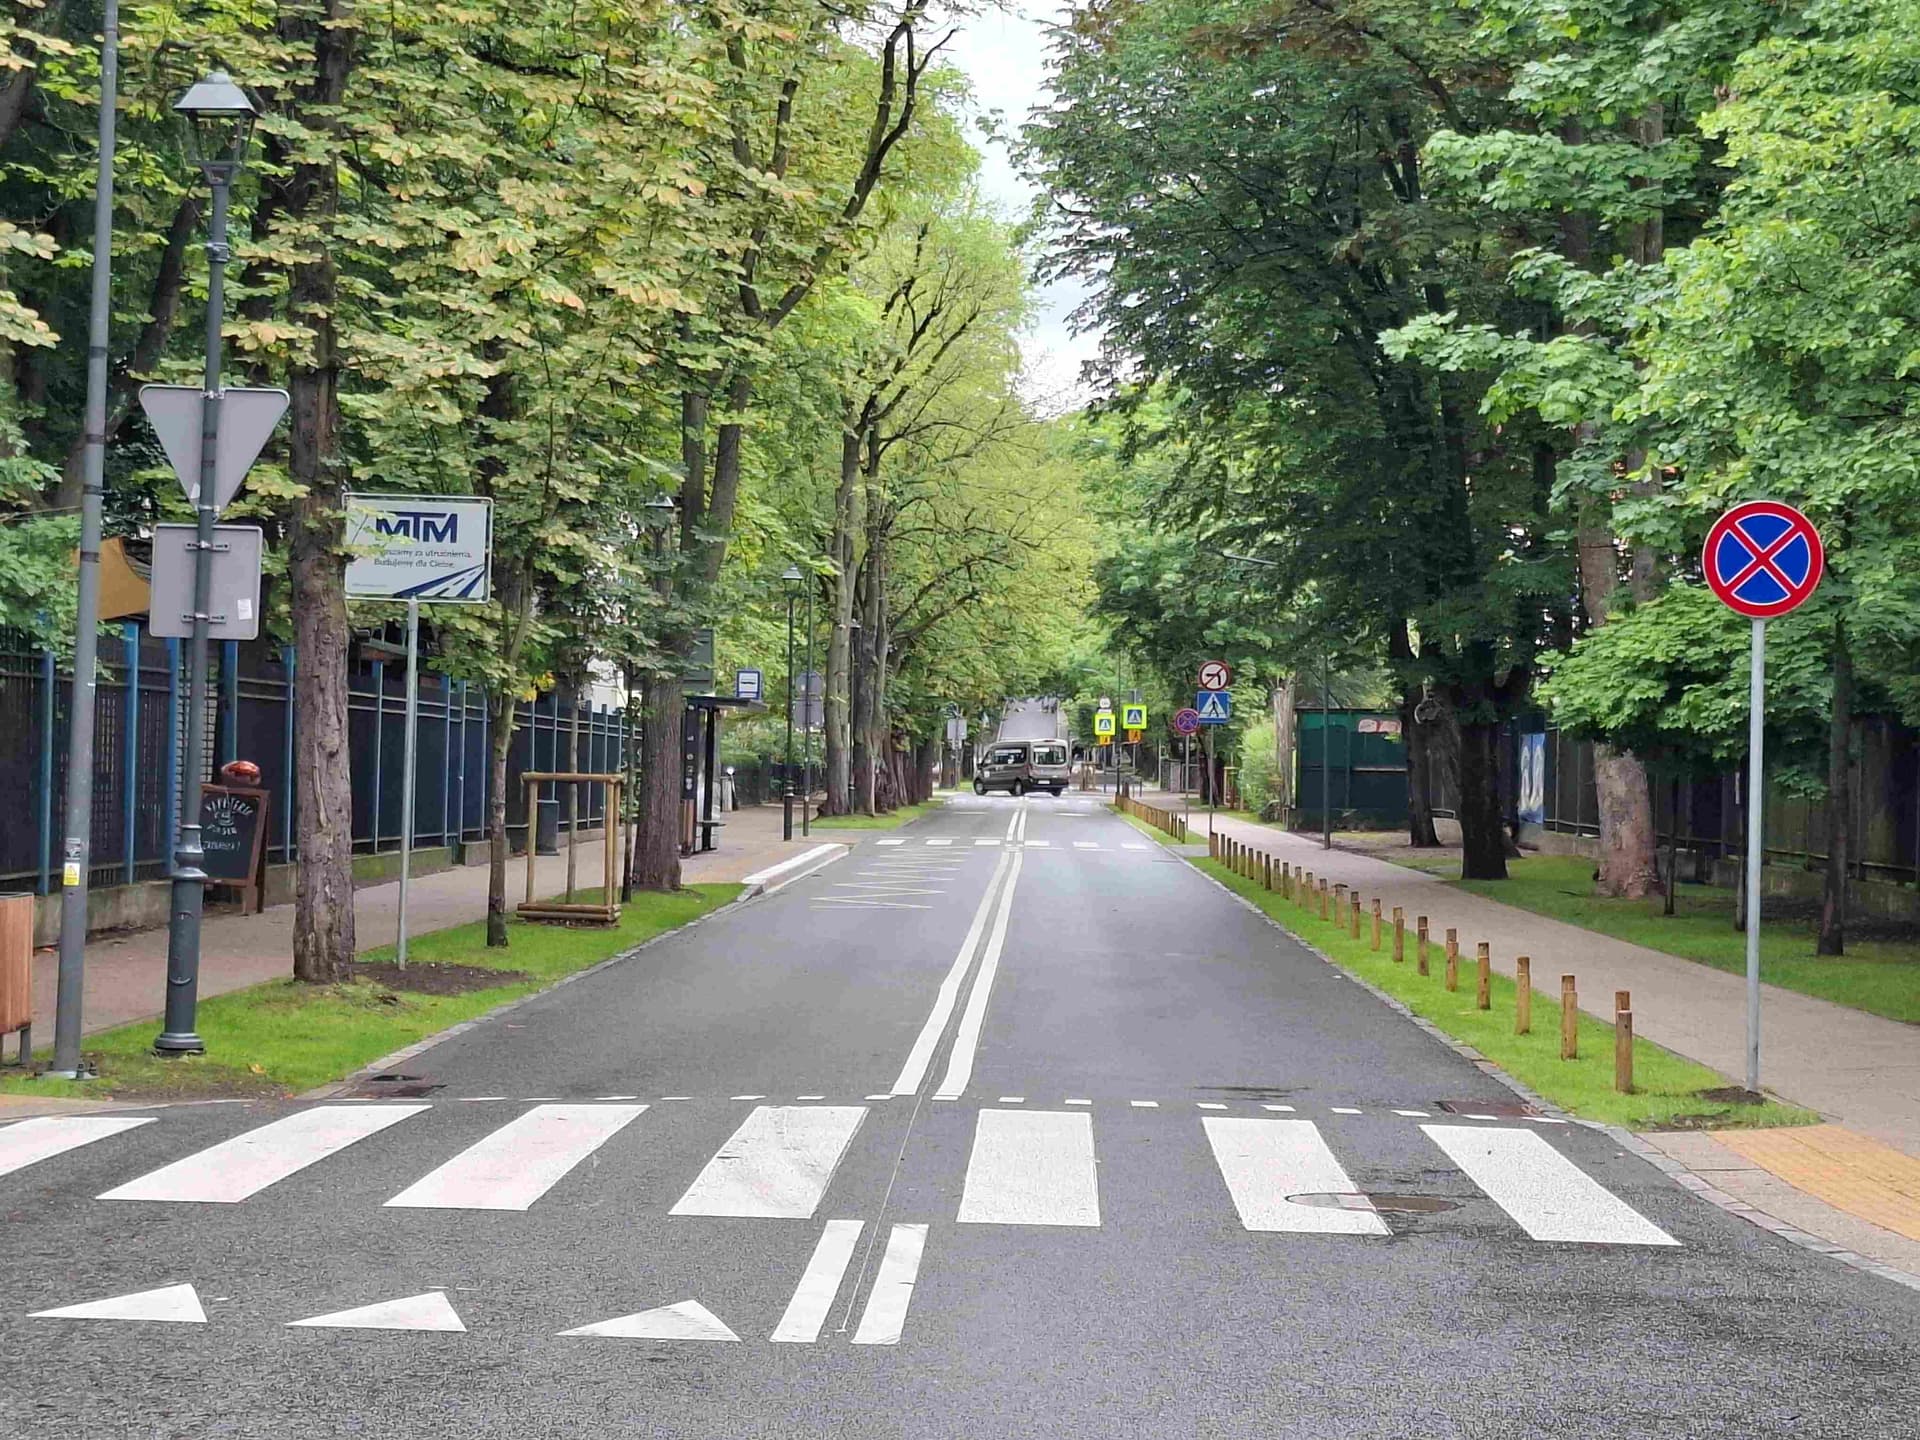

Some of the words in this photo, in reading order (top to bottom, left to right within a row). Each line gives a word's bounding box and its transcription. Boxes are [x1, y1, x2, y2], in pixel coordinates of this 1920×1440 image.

[376, 511, 458, 544] MTM
[374, 558, 413, 568] Budujemy
[416, 559, 427, 567] dla
